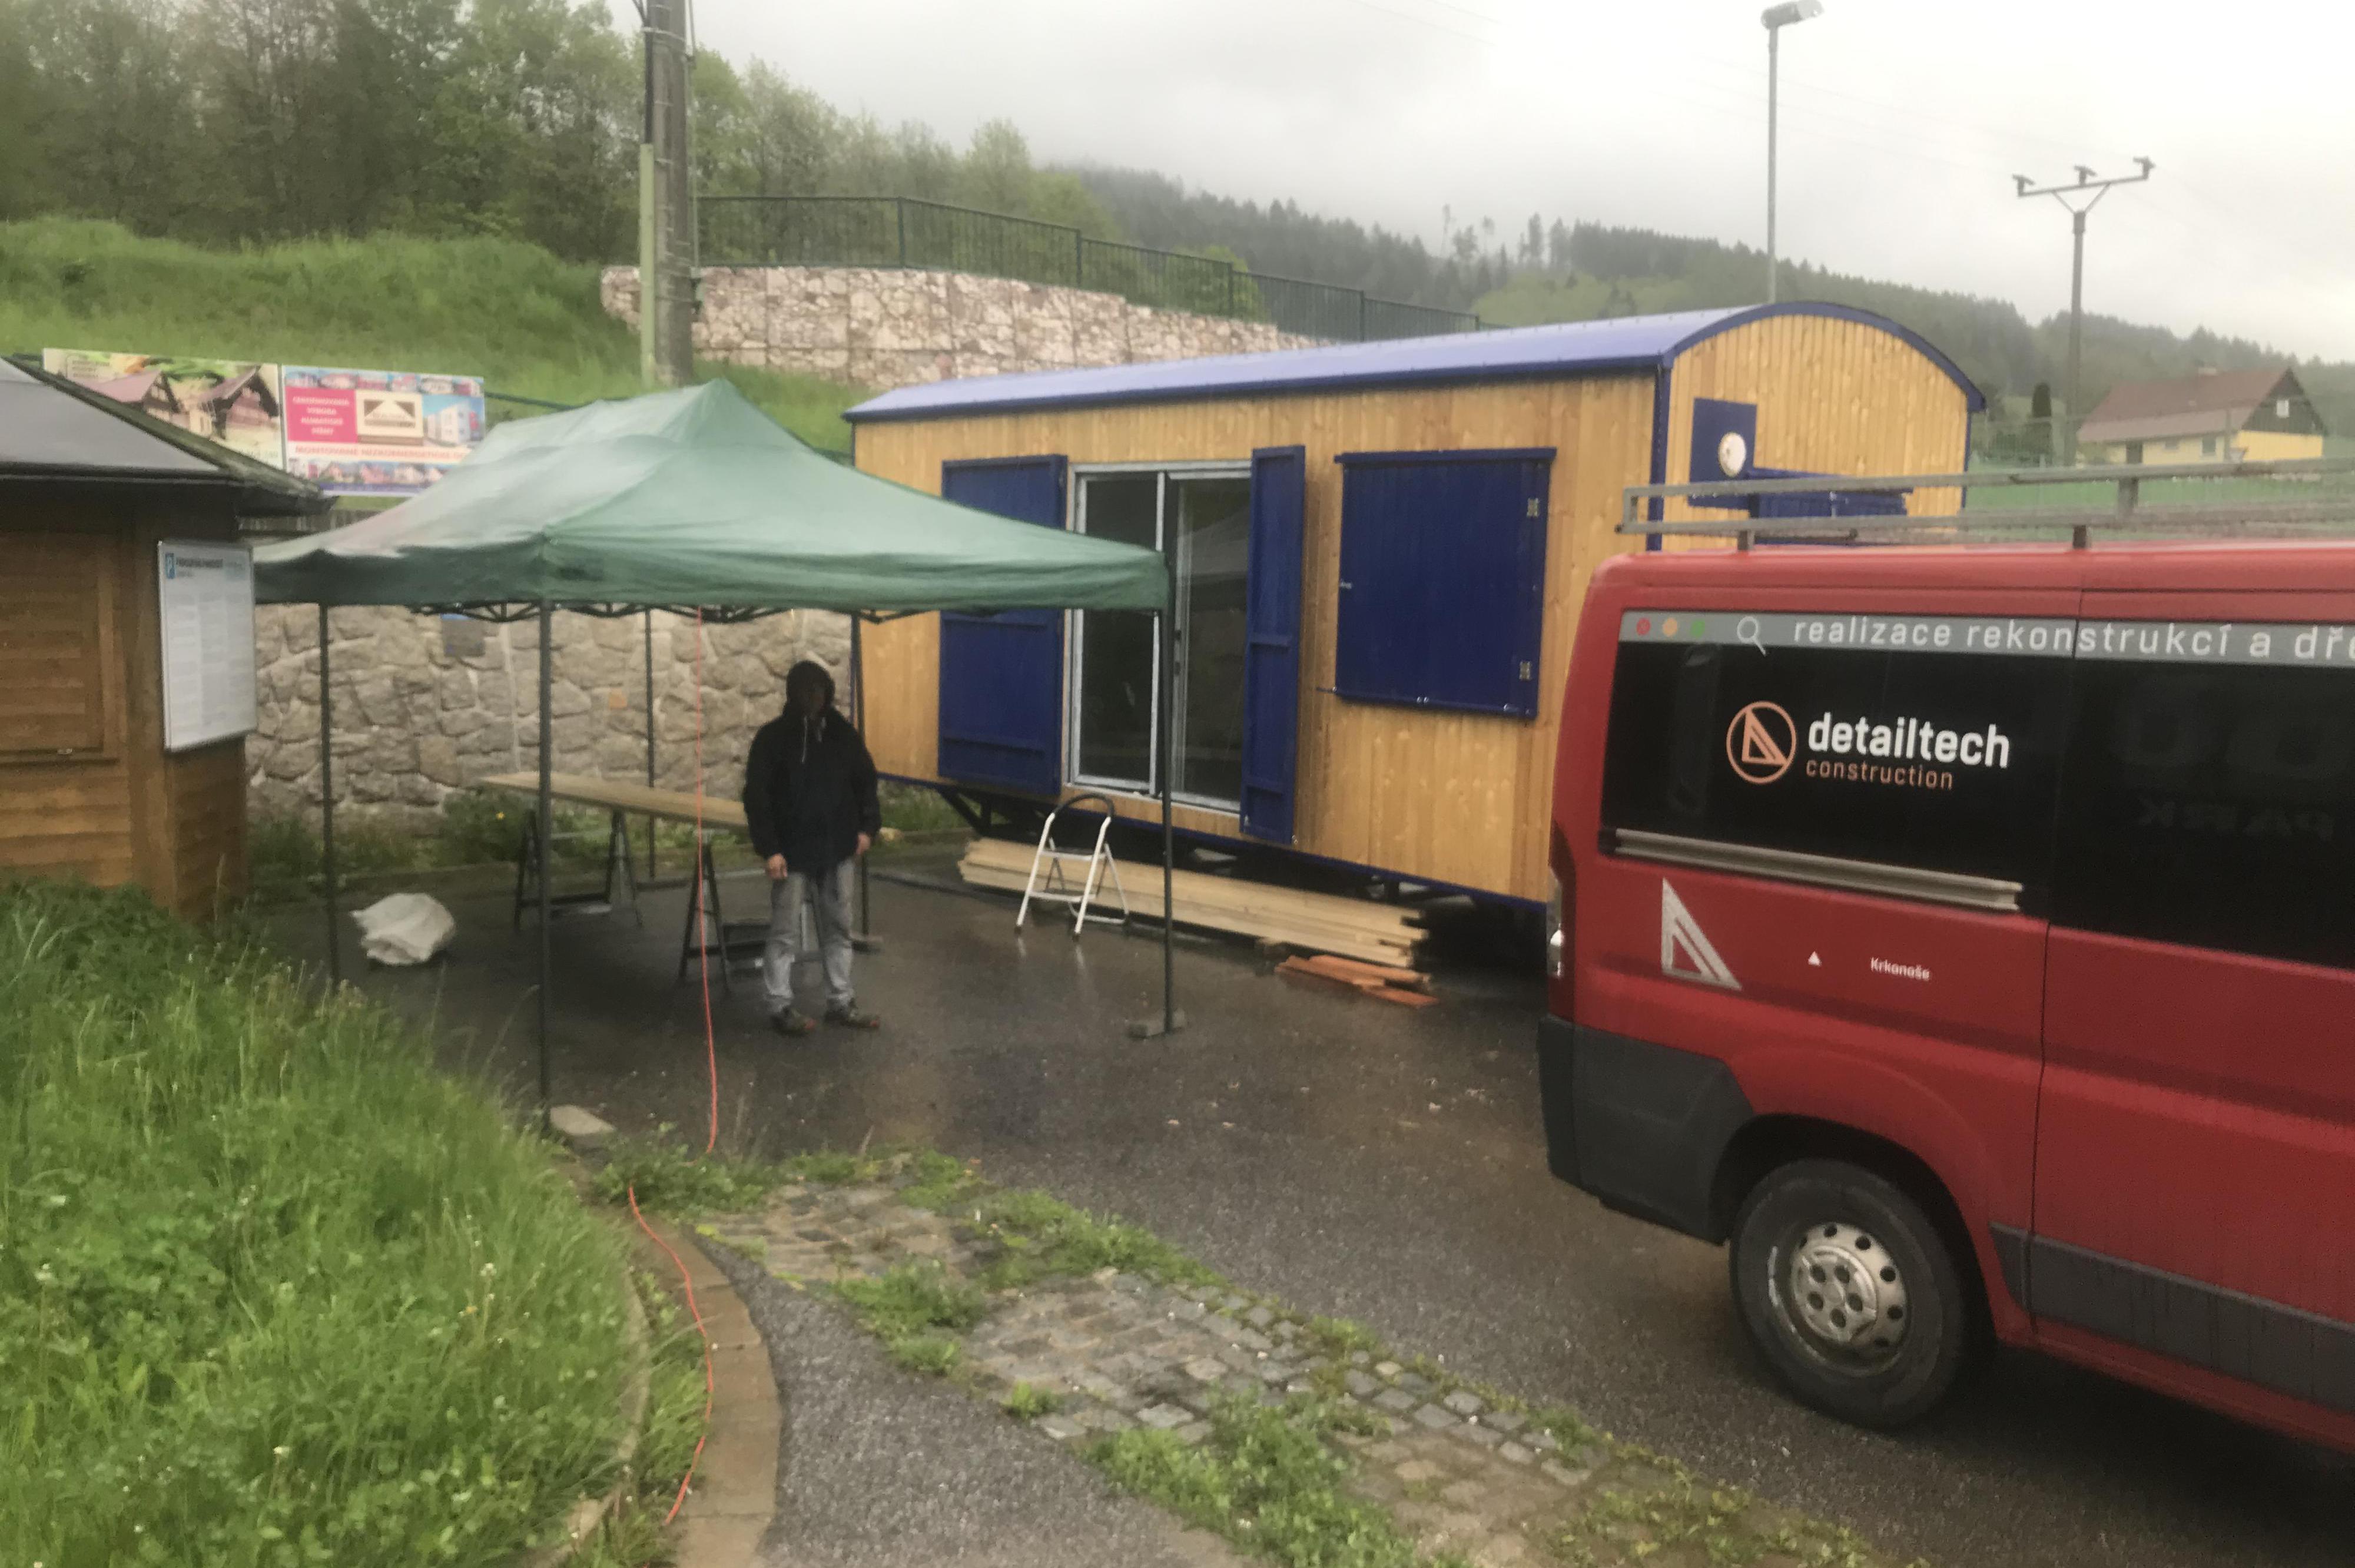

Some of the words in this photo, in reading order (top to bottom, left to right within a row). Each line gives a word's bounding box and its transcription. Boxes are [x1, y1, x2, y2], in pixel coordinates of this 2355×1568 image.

[1794, 616, 1952, 647] realizace
[1967, 619, 2232, 657] rekonstrukcí
[2250, 632, 2271, 658] a
[1808, 711, 2010, 768] detailtech
[1806, 760, 1953, 790] construction
[1870, 957, 1930, 982] Krkonoše
